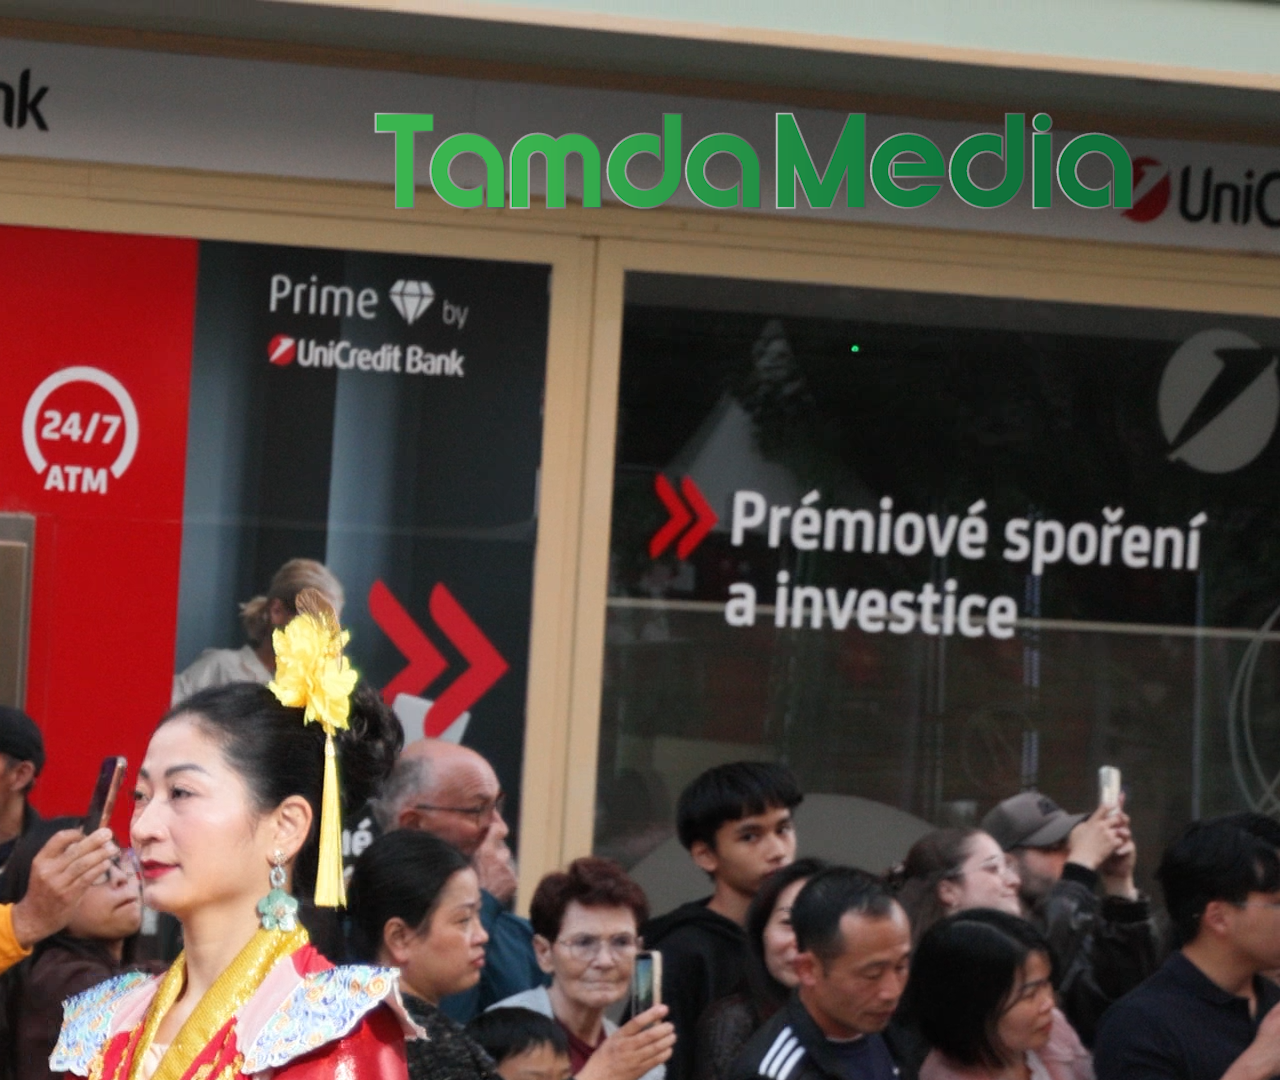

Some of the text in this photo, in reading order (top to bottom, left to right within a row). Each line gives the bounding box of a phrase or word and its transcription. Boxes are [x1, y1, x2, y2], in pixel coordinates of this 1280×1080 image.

[269, 274, 469, 329] Prime by
[297, 339, 465, 377] UniCredit Bank
[41, 409, 122, 444] 24/7
[43, 465, 109, 494] ATM
[730, 489, 1207, 576] Prémiové spoření
[724, 570, 1018, 638] a investice
